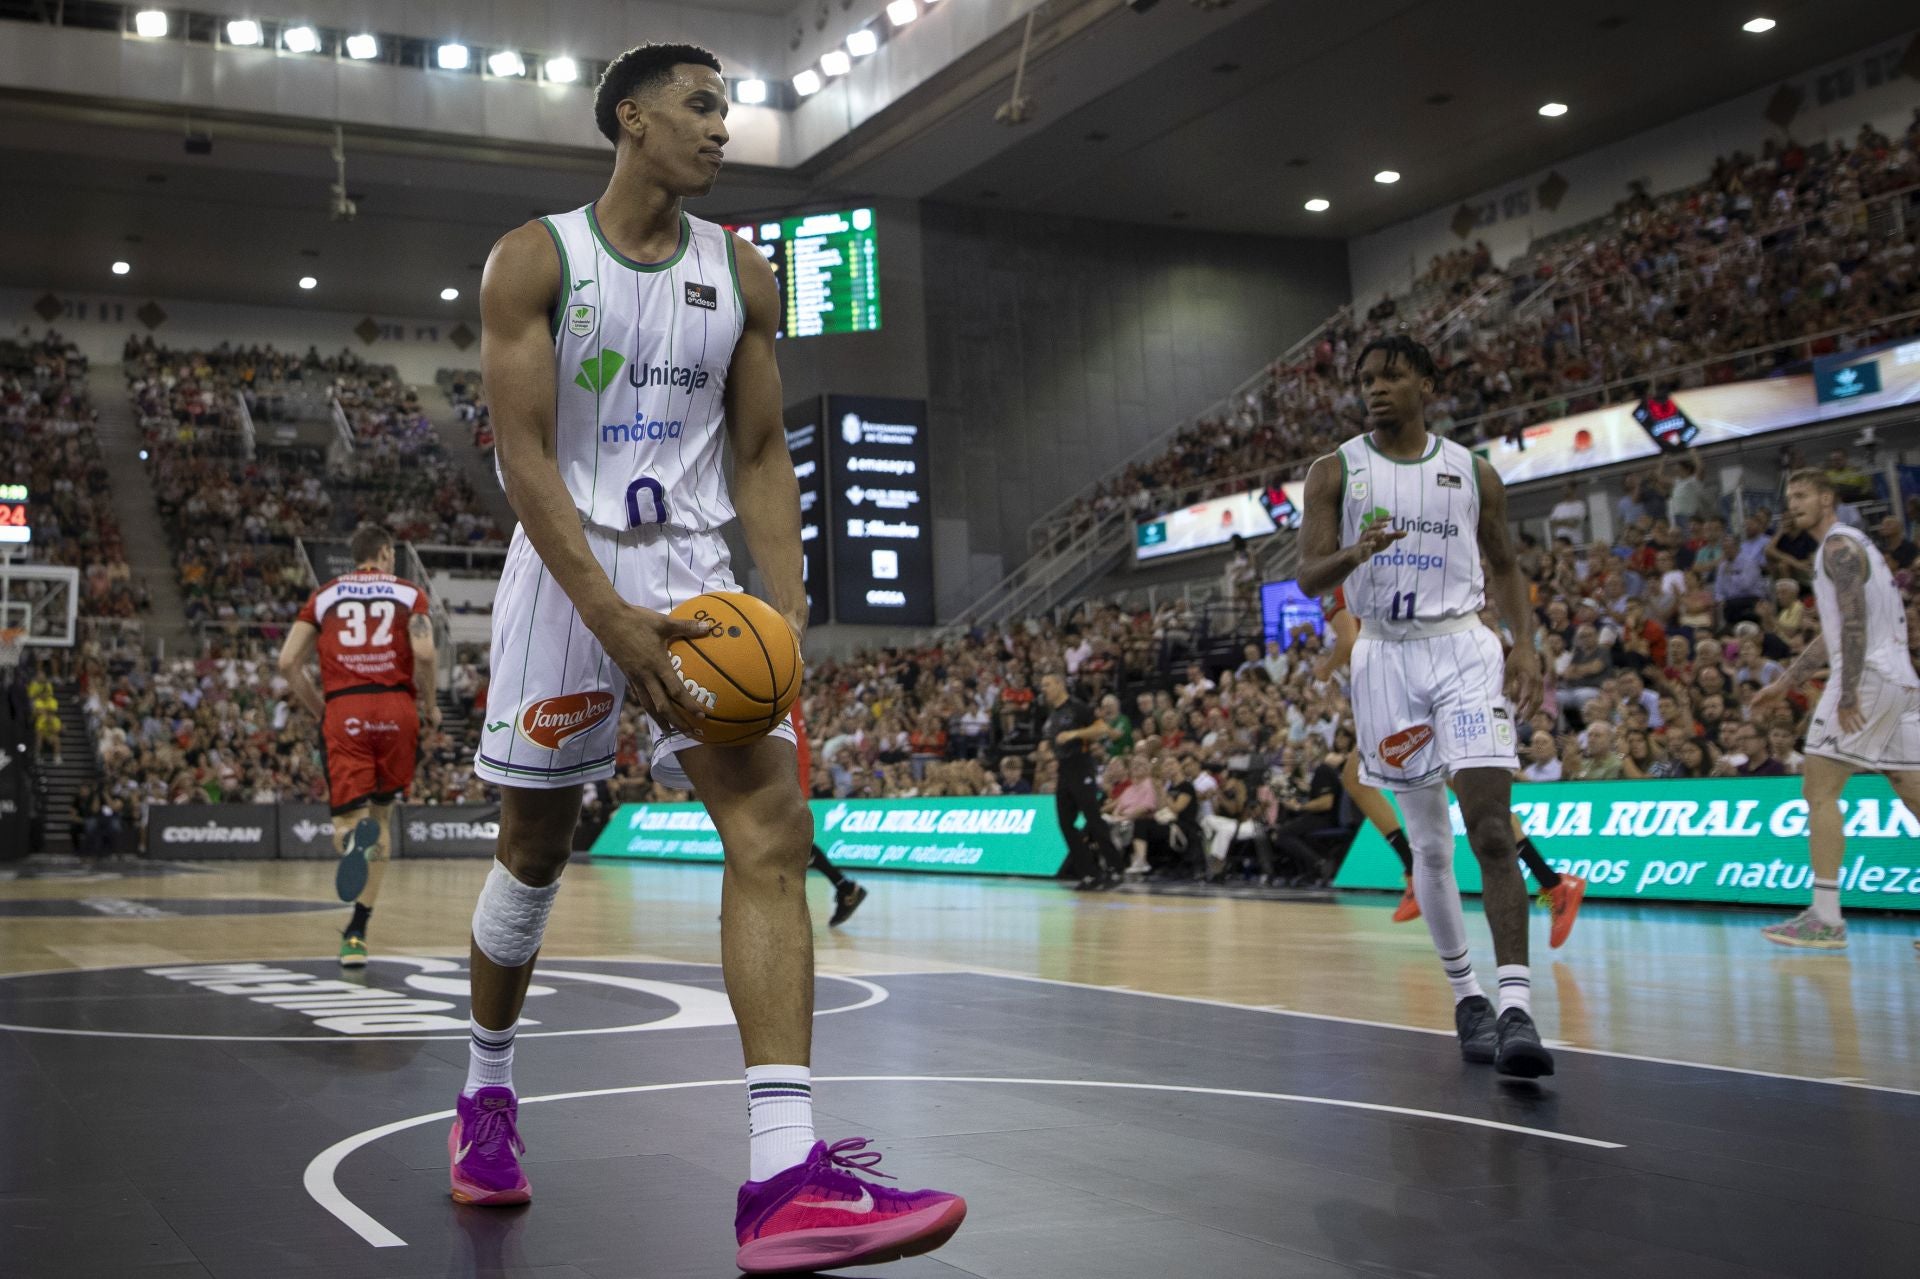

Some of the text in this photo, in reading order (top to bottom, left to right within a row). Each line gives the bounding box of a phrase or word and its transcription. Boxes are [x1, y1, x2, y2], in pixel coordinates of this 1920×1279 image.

[687, 288, 701, 298] liga
[687, 297, 716, 308] endesa
[629, 360, 709, 395] Unicaja
[1391, 516, 1459, 540] Unicaja
[1373, 548, 1443, 571] máaga
[337, 585, 395, 596] PULEVA
[1391, 591, 1416, 620] 11
[337, 600, 395, 647] 32
[526, 696, 612, 734] famadesa
[937, 808, 1037, 834] GRANADA
[1599, 800, 1763, 838] RURAL
[879, 845, 911, 864] por
[1636, 859, 1707, 894] por
